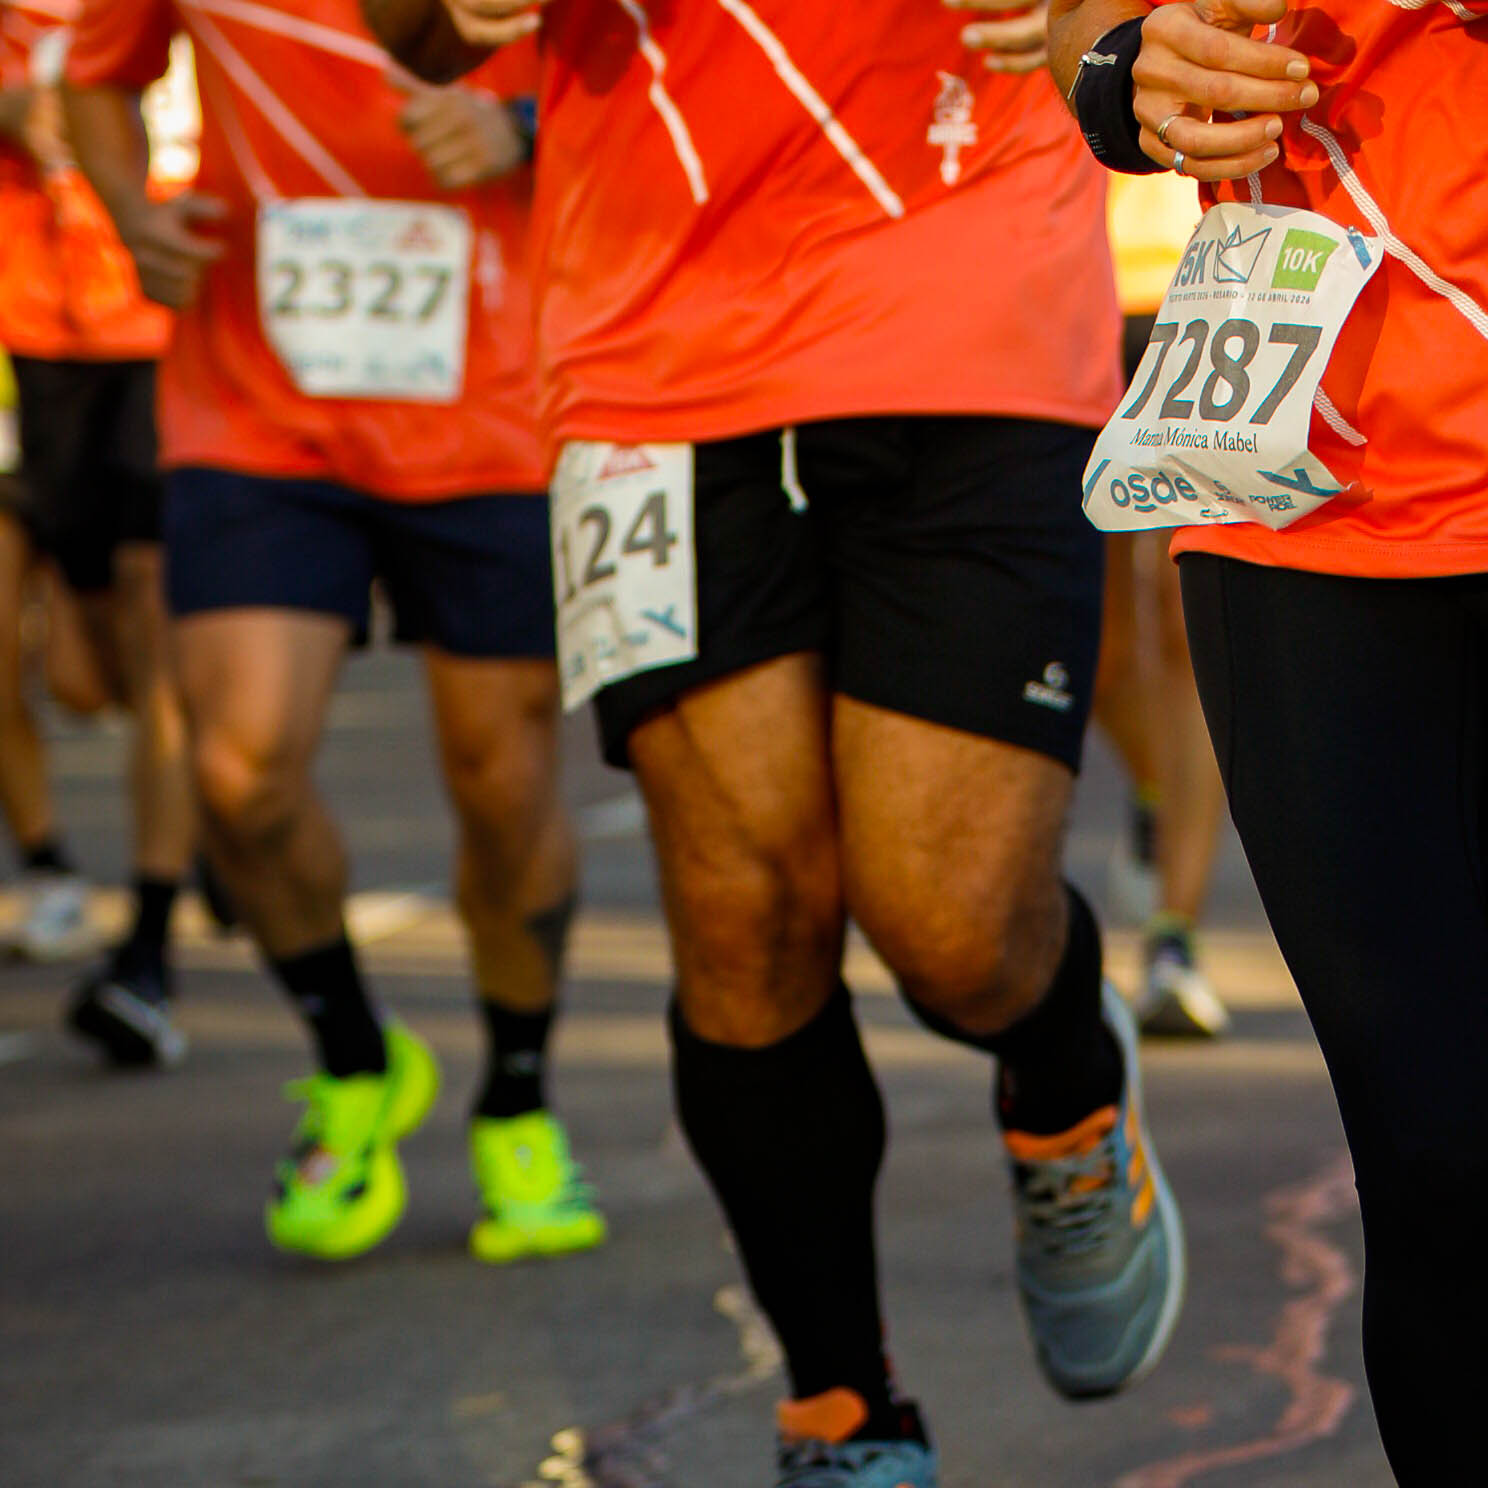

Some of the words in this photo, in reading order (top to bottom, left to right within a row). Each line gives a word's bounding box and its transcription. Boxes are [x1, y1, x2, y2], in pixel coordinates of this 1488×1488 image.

[1282, 247, 1324, 274] 10K
[270, 259, 452, 325] 2327
[1121, 319, 1323, 426] 7287
[1213, 430, 1258, 453] Mabel
[1110, 471, 1198, 508] osde
[561, 489, 678, 602] 24
